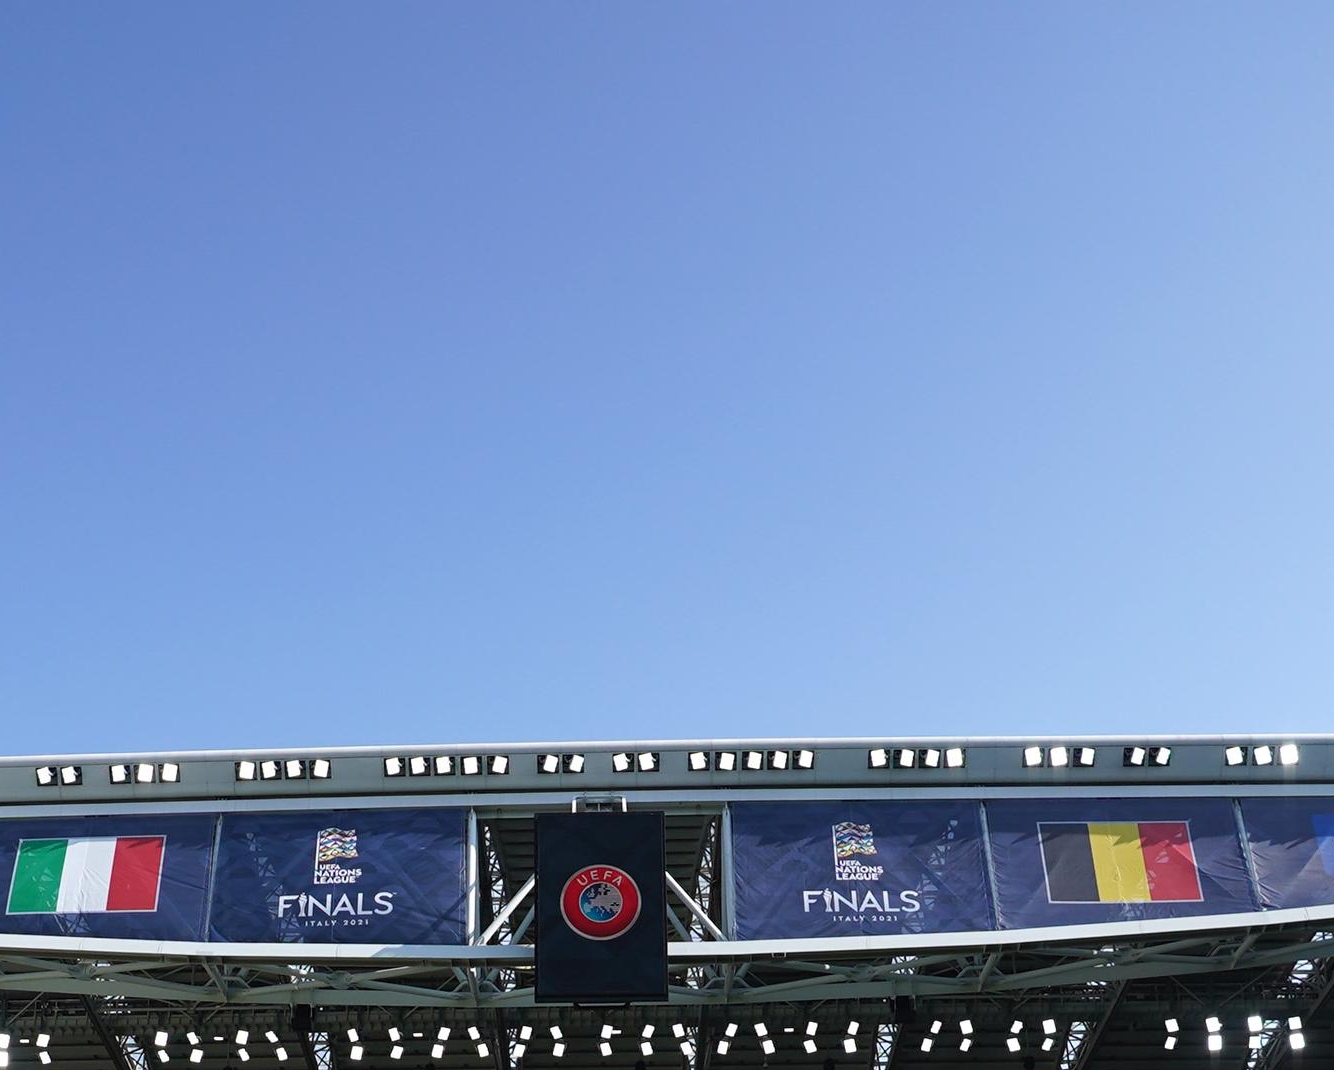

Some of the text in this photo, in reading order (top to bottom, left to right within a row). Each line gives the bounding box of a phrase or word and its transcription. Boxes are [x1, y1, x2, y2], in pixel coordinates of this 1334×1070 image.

[314, 868, 362, 877] NATIONS
[835, 865, 884, 874] NATIONS
[313, 875, 356, 885] LEAGUE
[577, 869, 623, 887] UEFA
[835, 872, 879, 881] LEAGUE
[277, 891, 394, 918] FINALS
[802, 887, 921, 913] FINALS
[343, 918, 369, 926] 2021
